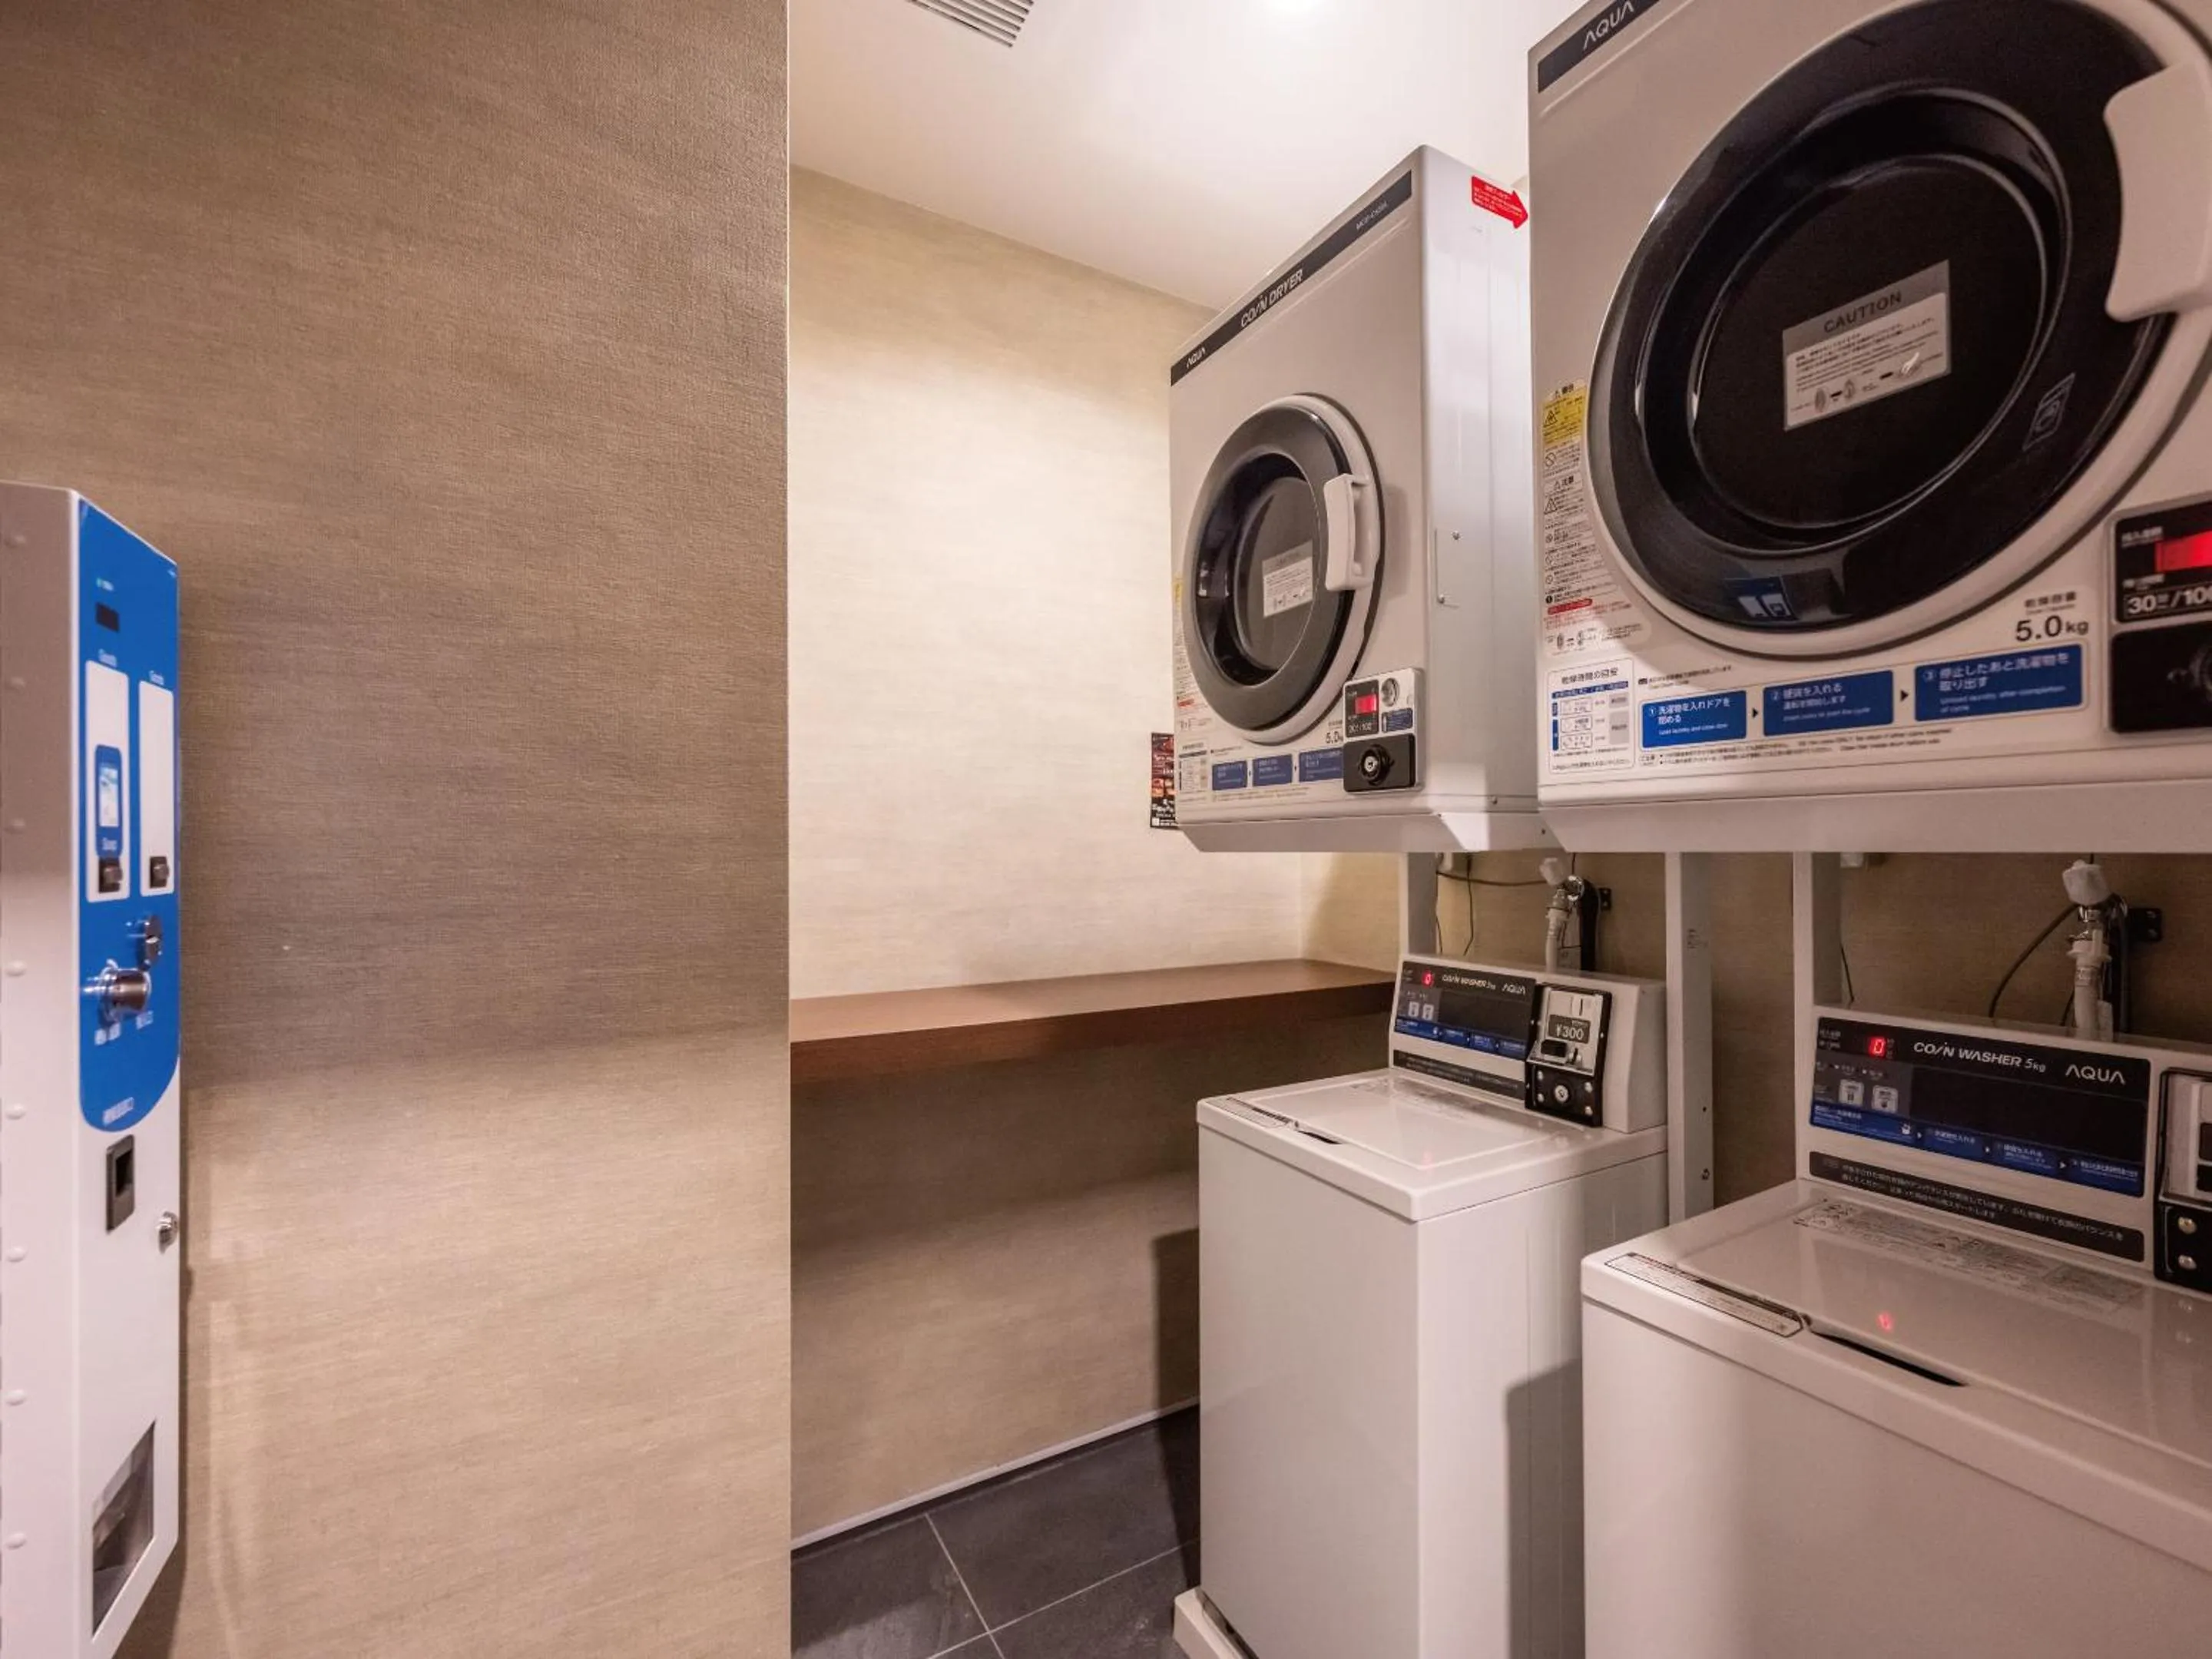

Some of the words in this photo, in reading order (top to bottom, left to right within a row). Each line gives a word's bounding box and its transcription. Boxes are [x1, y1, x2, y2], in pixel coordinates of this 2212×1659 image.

[1583, 1, 1634, 51] AQUA
[1269, 269, 1303, 304] DRYER
[1823, 290, 1902, 333] CAUTION
[1556, 1023, 1584, 1041] ¥300
[1958, 1048, 2022, 1067] WASHER
[2025, 1057, 2046, 1073] 5kg
[2065, 1064, 2126, 1085] AQUA
